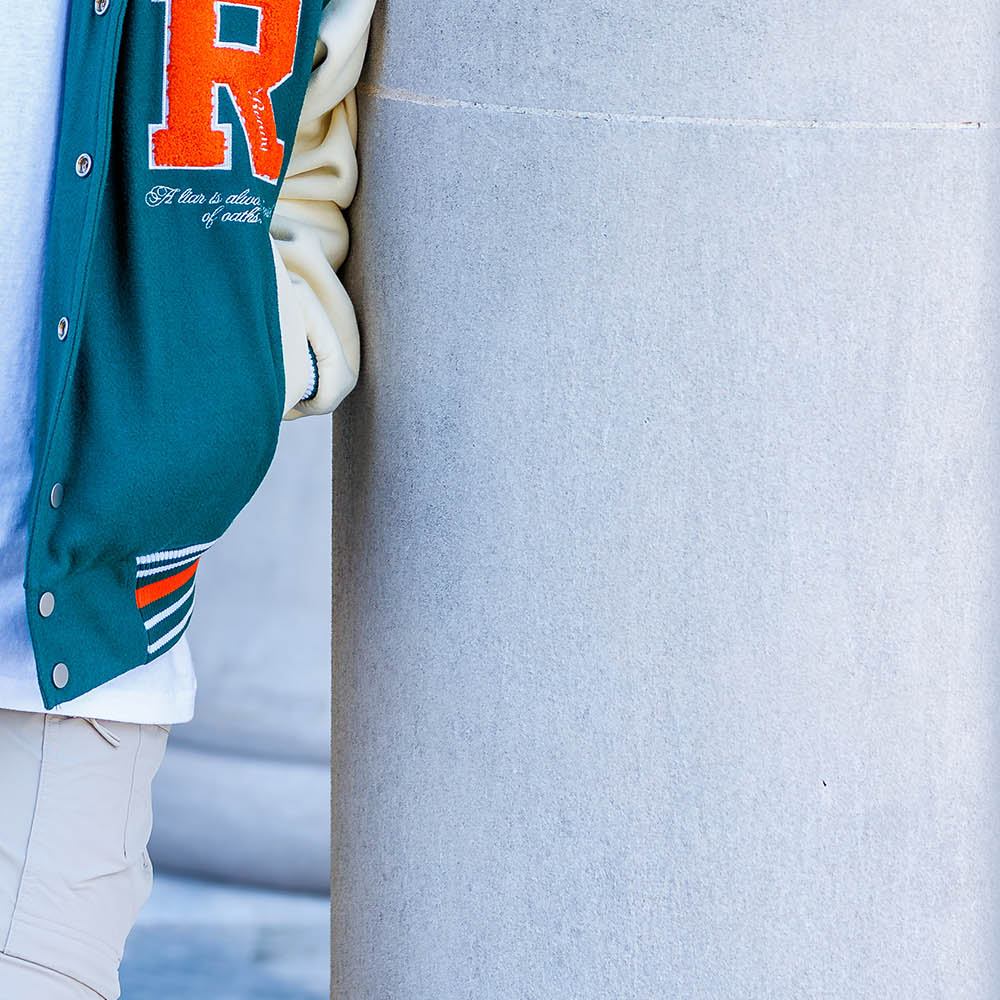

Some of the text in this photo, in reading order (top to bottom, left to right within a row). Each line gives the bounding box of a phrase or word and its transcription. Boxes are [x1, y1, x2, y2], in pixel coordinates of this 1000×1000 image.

[144, 185, 264, 208] A liar is alwa
[201, 204, 225, 230] of
